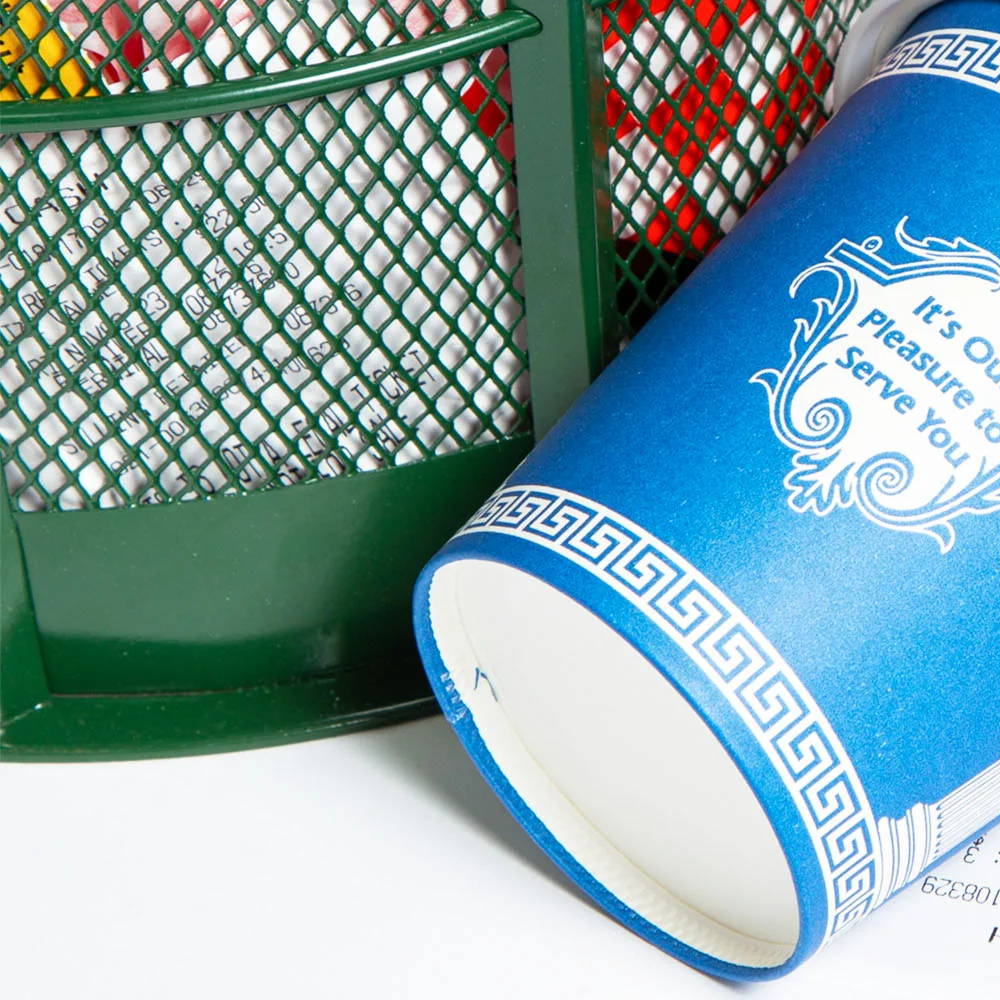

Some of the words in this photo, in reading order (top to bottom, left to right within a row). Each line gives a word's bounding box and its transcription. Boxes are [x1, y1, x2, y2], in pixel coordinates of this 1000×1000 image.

[836, 345, 917, 416] Serve
[917, 406, 970, 468] You
[858, 307, 976, 410] Pleasure
[962, 844, 977, 865] 3
